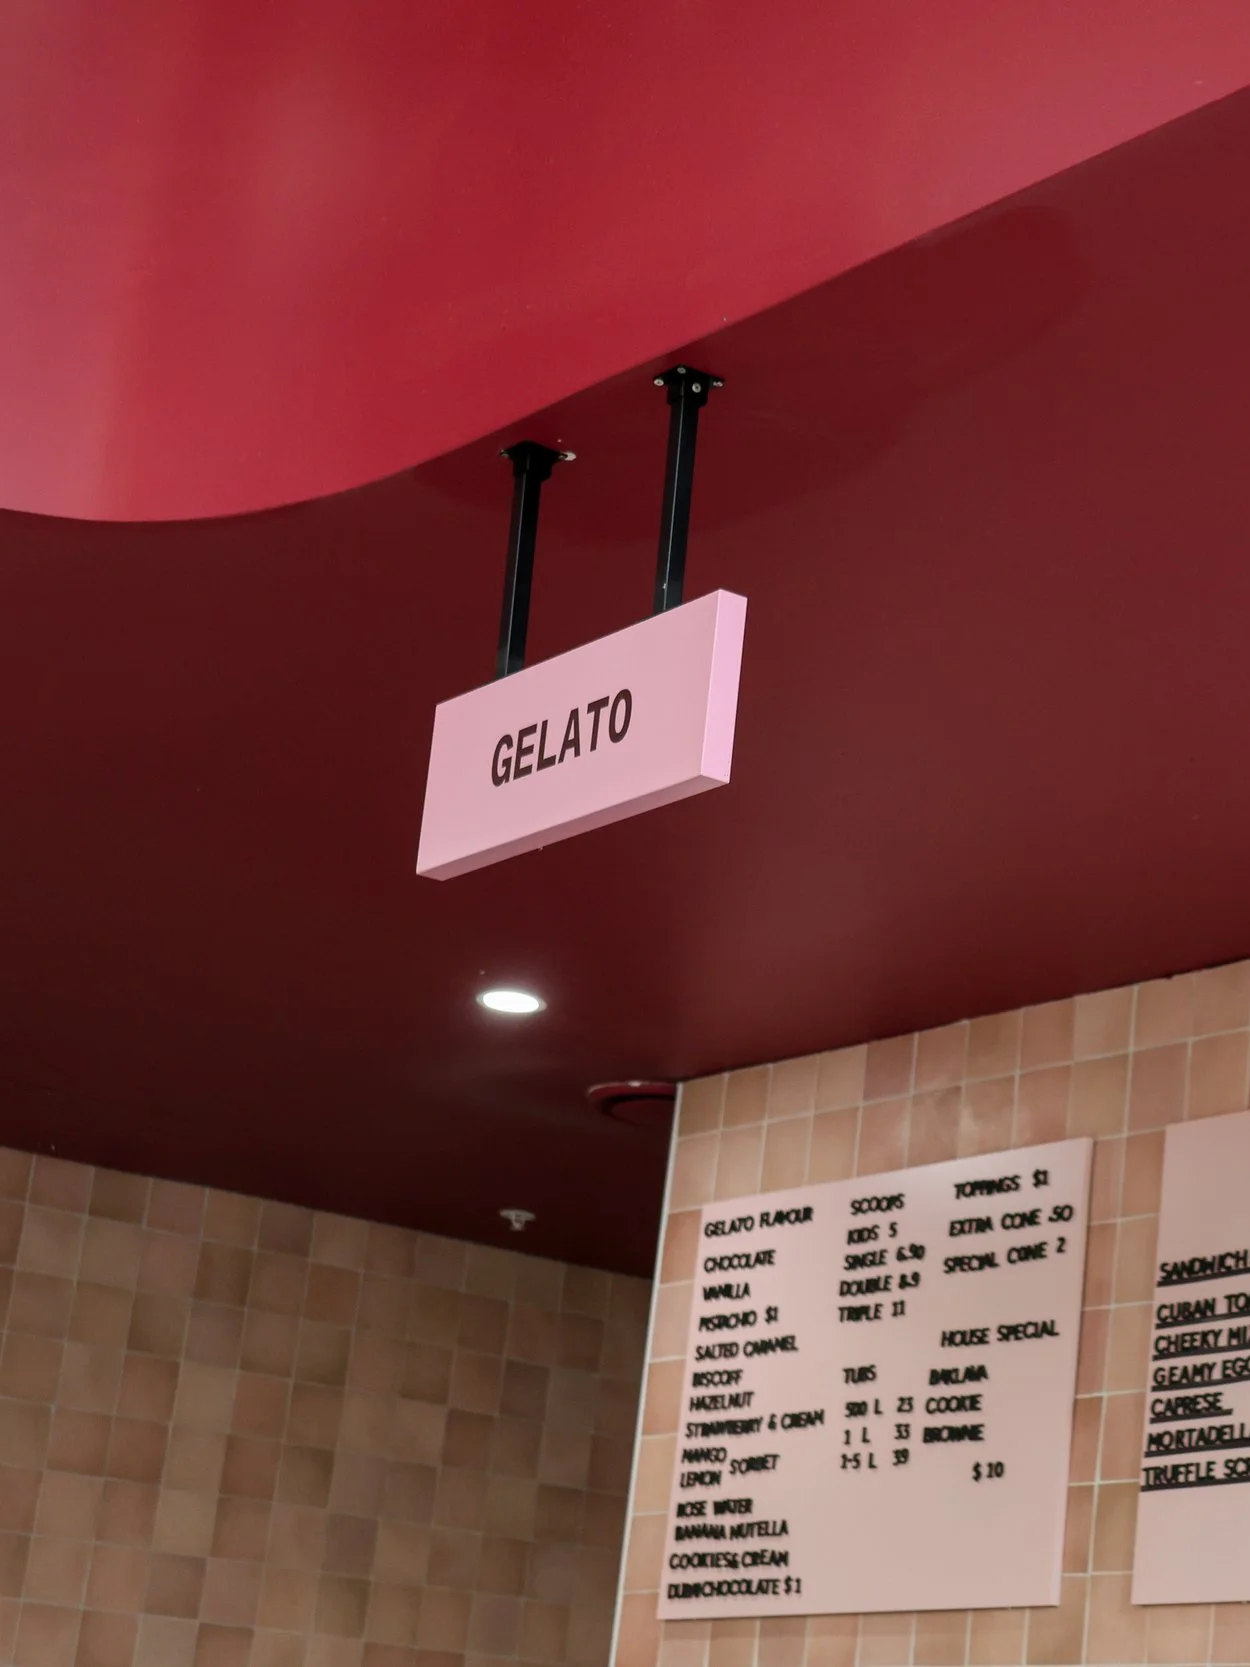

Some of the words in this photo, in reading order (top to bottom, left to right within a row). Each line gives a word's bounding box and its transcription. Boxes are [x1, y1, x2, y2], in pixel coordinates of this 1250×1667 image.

[491, 689, 632, 787] GELATO
[954, 1174, 1021, 1200] TOPPINGS
[850, 1193, 905, 1216] SCOOPS
[704, 1215, 755, 1238] GELATO
[759, 1206, 814, 1228] FLAVOUR
[948, 1216, 994, 1238] EXTRA
[1000, 1208, 1042, 1231] CONE
[846, 1224, 880, 1246] KIDS
[703, 1249, 776, 1273] CHOCOLATE
[843, 1248, 888, 1271] SINGLE
[943, 1251, 1000, 1275] SPECIAL
[1006, 1241, 1048, 1265] CONE
[1055, 1236, 1067, 1254] 2
[702, 1282, 750, 1301] VANILLA
[839, 1274, 893, 1297] DOUBLE
[838, 1303, 883, 1323] TRIPLE
[891, 1299, 906, 1318] 11
[1157, 1299, 1215, 1323] CUBAN
[940, 1327, 991, 1348] HOUSE
[996, 1319, 1060, 1342] SPECIAL
[1154, 1329, 1222, 1354] CHEEKY
[695, 1342, 740, 1362] SALTED
[743, 1335, 798, 1358] CARAMEL
[692, 1369, 743, 1388] BISCOFF
[843, 1364, 877, 1384] TUBS
[689, 1391, 754, 1411] HAZELNUT
[874, 1398, 883, 1415] L
[896, 1396, 914, 1413] 23
[925, 1393, 983, 1415] COOKIE
[1151, 1392, 1224, 1417] CAPRESE
[685, 1416, 764, 1439] STRAWBERRY
[780, 1409, 825, 1430] CREAM
[861, 1427, 871, 1444] L
[681, 1447, 727, 1464] MANGO
[729, 1454, 780, 1475] SORBET
[868, 1452, 877, 1469] L
[679, 1470, 722, 1489] LEMON
[1143, 1461, 1217, 1485] TRUFFLE
[676, 1500, 707, 1518] ROSE
[712, 1498, 753, 1516] WATER
[674, 1523, 727, 1542] BANANA
[729, 1519, 789, 1541] NUTELLA
